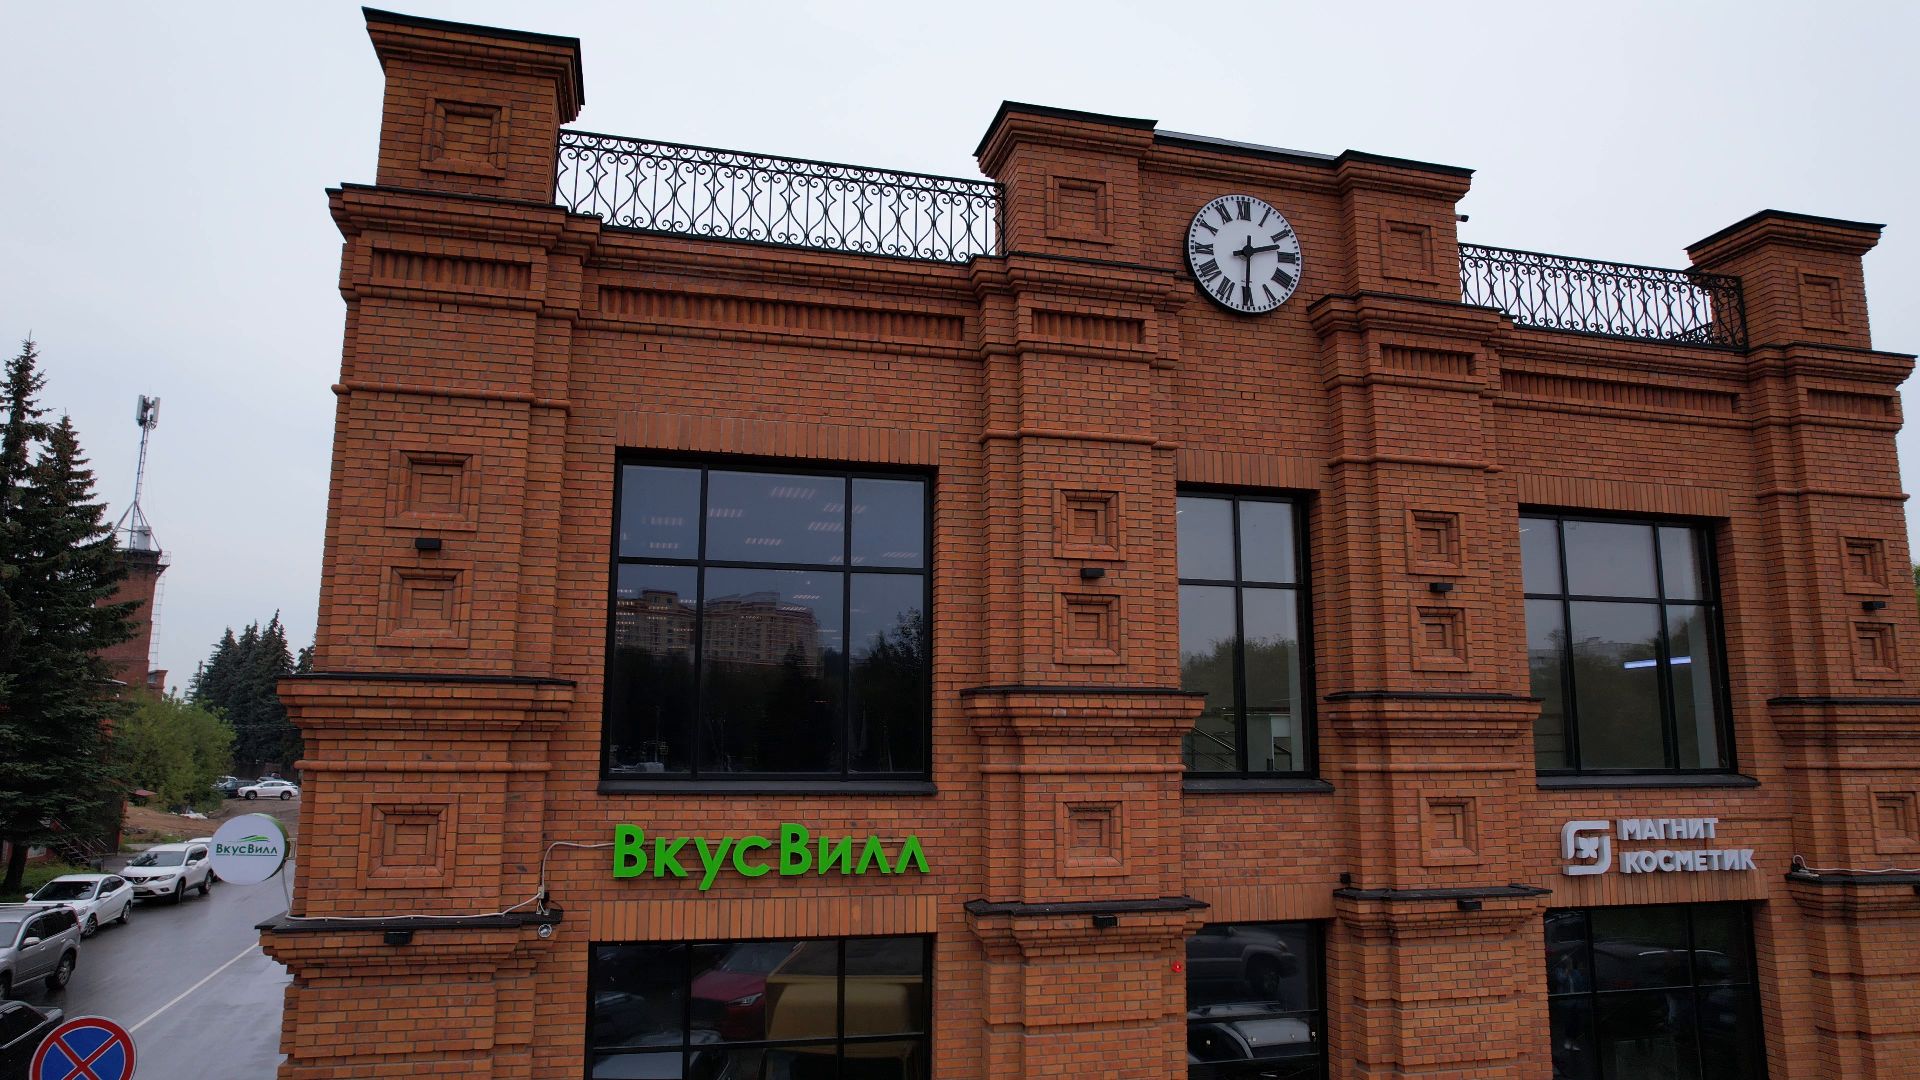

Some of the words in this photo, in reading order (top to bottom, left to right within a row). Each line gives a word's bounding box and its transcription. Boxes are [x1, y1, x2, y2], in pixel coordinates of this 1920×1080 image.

[1214, 202, 1232, 224] XI
[1236, 200, 1251, 221] XII
[1199, 219, 1218, 235] X
[1276, 250, 1295, 264] III
[1617, 818, 1718, 840] МАГНИТ
[215, 843, 278, 856] ВкусВилл
[613, 822, 931, 891] ВкусВилл
[1620, 850, 1756, 873] КОСМЕТИК
